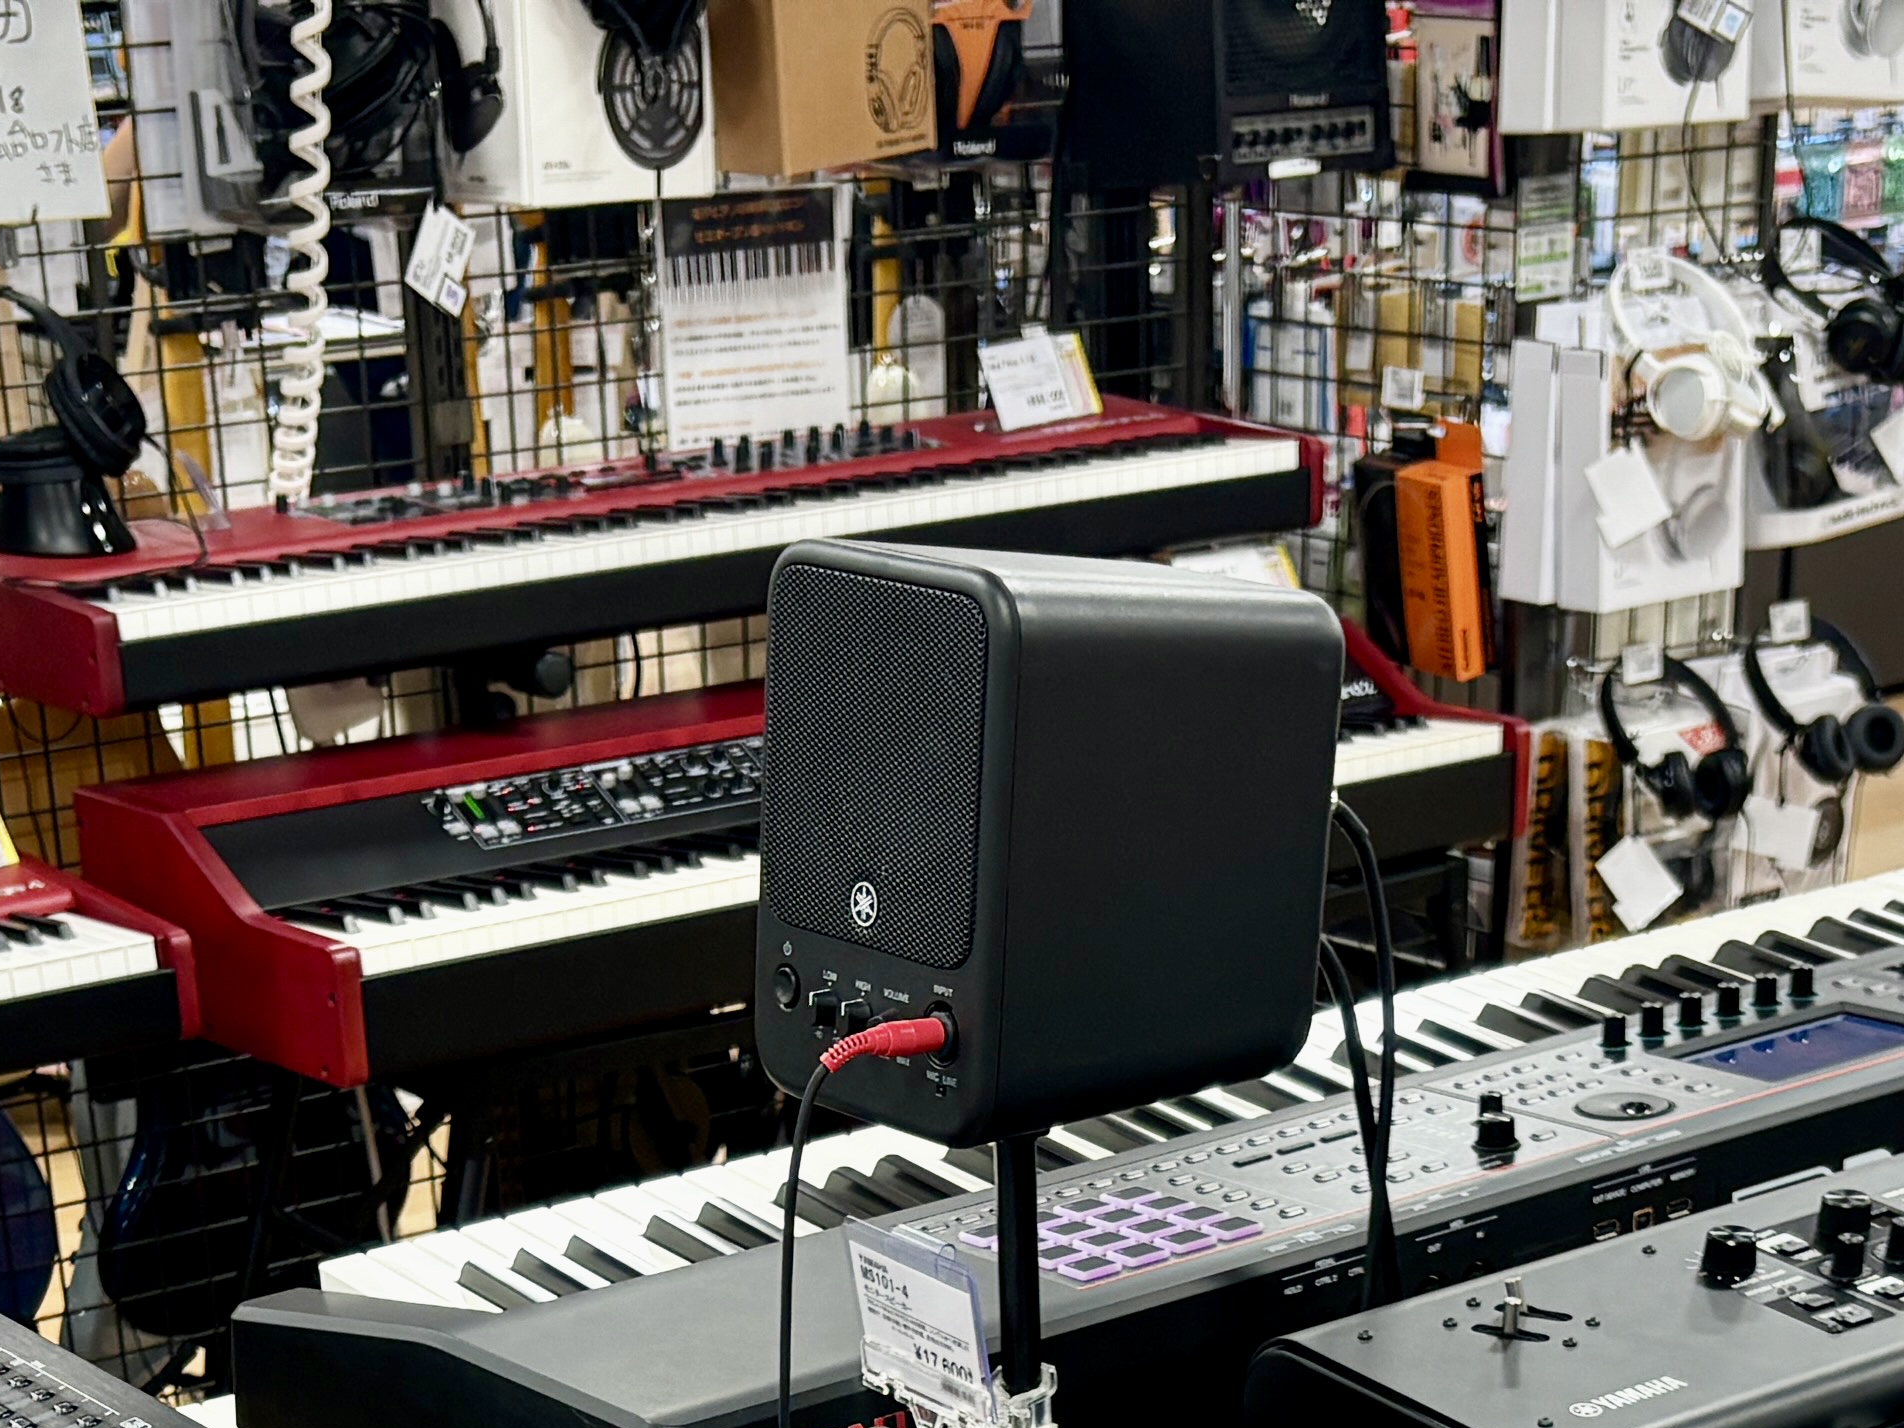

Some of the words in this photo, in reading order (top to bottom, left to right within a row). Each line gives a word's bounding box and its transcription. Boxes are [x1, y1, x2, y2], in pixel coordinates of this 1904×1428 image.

[822, 969, 838, 982] LOW
[883, 988, 910, 1004] VOLUME
[933, 984, 954, 998] INPUT
[860, 1264, 909, 1299] MS101-4
[1593, 1375, 1689, 1411] YAMAHA
